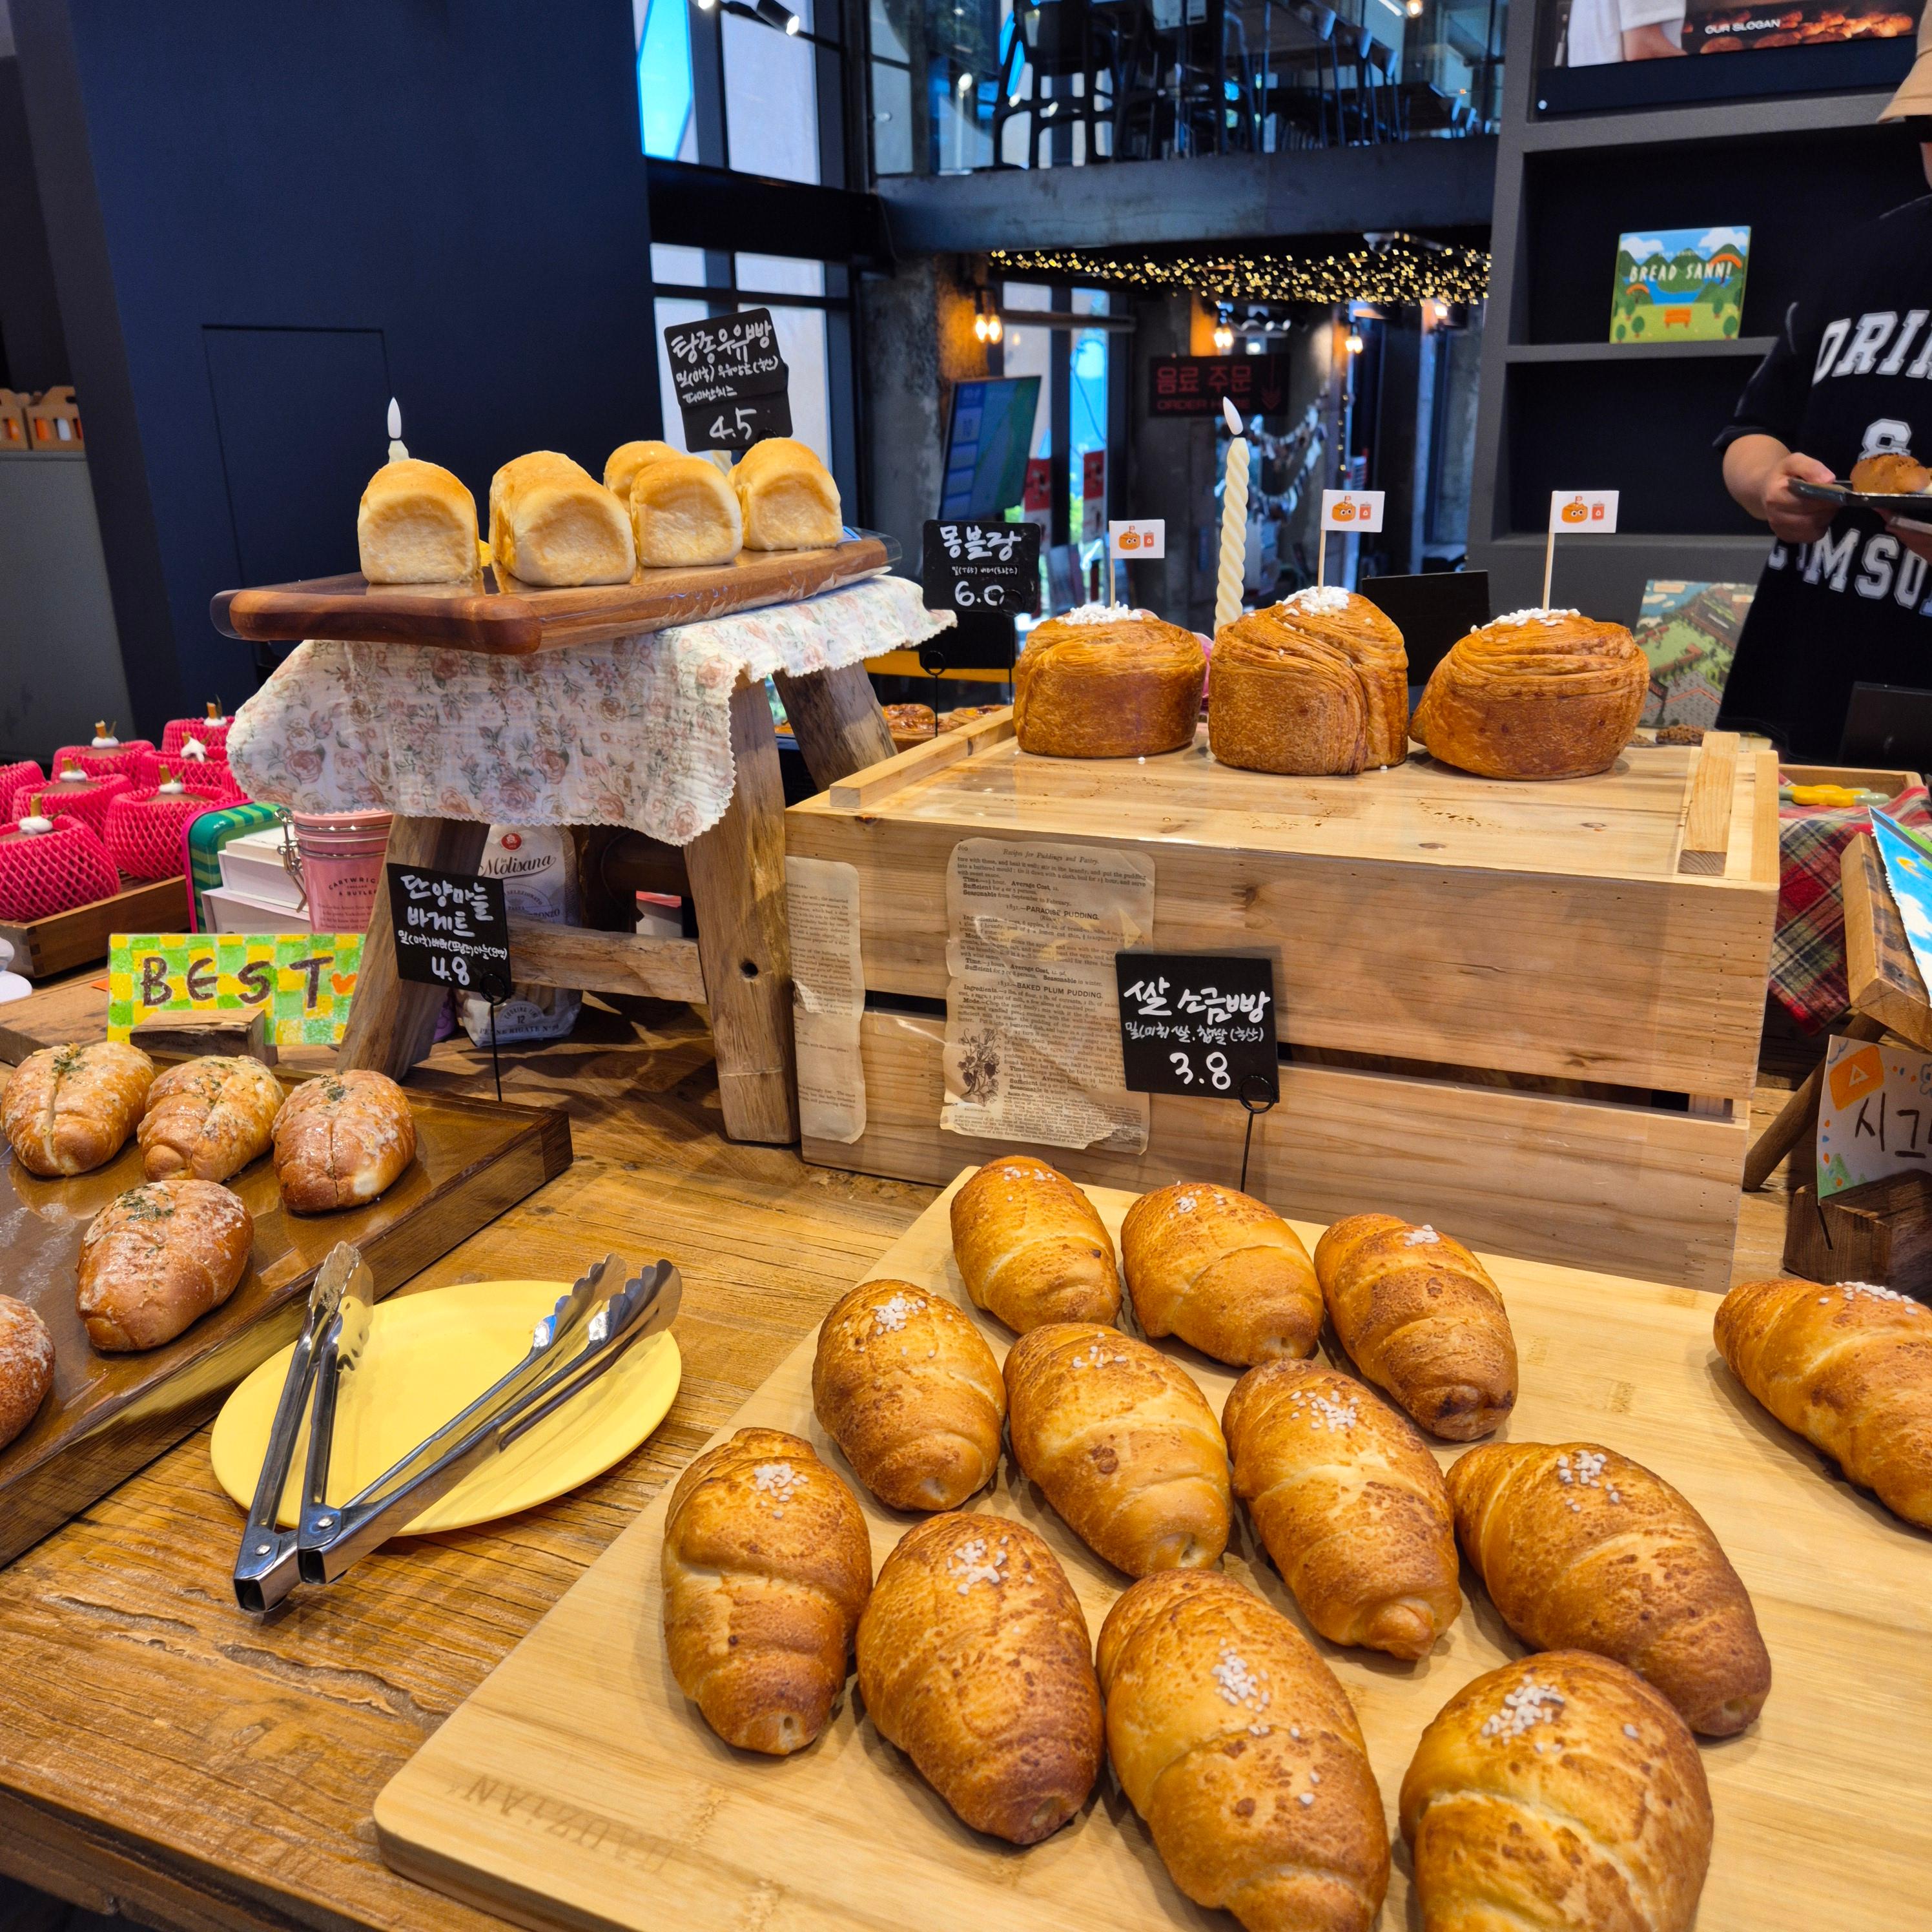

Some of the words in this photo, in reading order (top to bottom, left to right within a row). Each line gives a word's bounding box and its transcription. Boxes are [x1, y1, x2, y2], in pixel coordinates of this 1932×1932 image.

[1705, 23, 1731, 34] OUR
[1732, 19, 1781, 32] SLOGAN
[1629, 263, 1678, 283] BREAD
[670, 320, 773, 364] 탕종우유빵
[1156, 365, 1200, 395] 음료
[1208, 365, 1252, 393] 주문
[1156, 399, 1208, 411] ORDER
[1211, 398, 1251, 410] HE
[709, 407, 757, 440] 4.5
[940, 525, 1022, 561] 몽블랑
[954, 581, 1005, 606] 6.0
[482, 854, 557, 877] Molisana
[963, 883, 992, 891] Sufficient
[963, 889, 997, 898] Seasonable
[1011, 879, 1035, 889] Average
[400, 874, 495, 921] 단양마늘
[407, 906, 489, 938] 바게트
[1064, 910, 1100, 921] PUDDING.
[431, 956, 471, 986] 4.8
[965, 964, 993, 973] Sufficient
[1043, 974, 1077, 985] Seasonable
[1010, 963, 1034, 972] Average
[140, 956, 334, 1010] BEST
[1043, 986, 1065, 995] PLUM
[1067, 989, 1104, 999] PUDDING.
[1123, 976, 1173, 1016] 쌀
[1177, 987, 1271, 1026] 소금빵
[509, 1025, 540, 1034] RIGATE
[517, 1015, 526, 1024] 12
[1042, 1075, 1066, 1085] Average
[1169, 1051, 1231, 1091] 3.8
[1009, 1078, 1038, 1087] Sufficient
[1009, 1084, 1043, 1093] Seasonable
[1855, 1092, 1932, 1159] 시그
